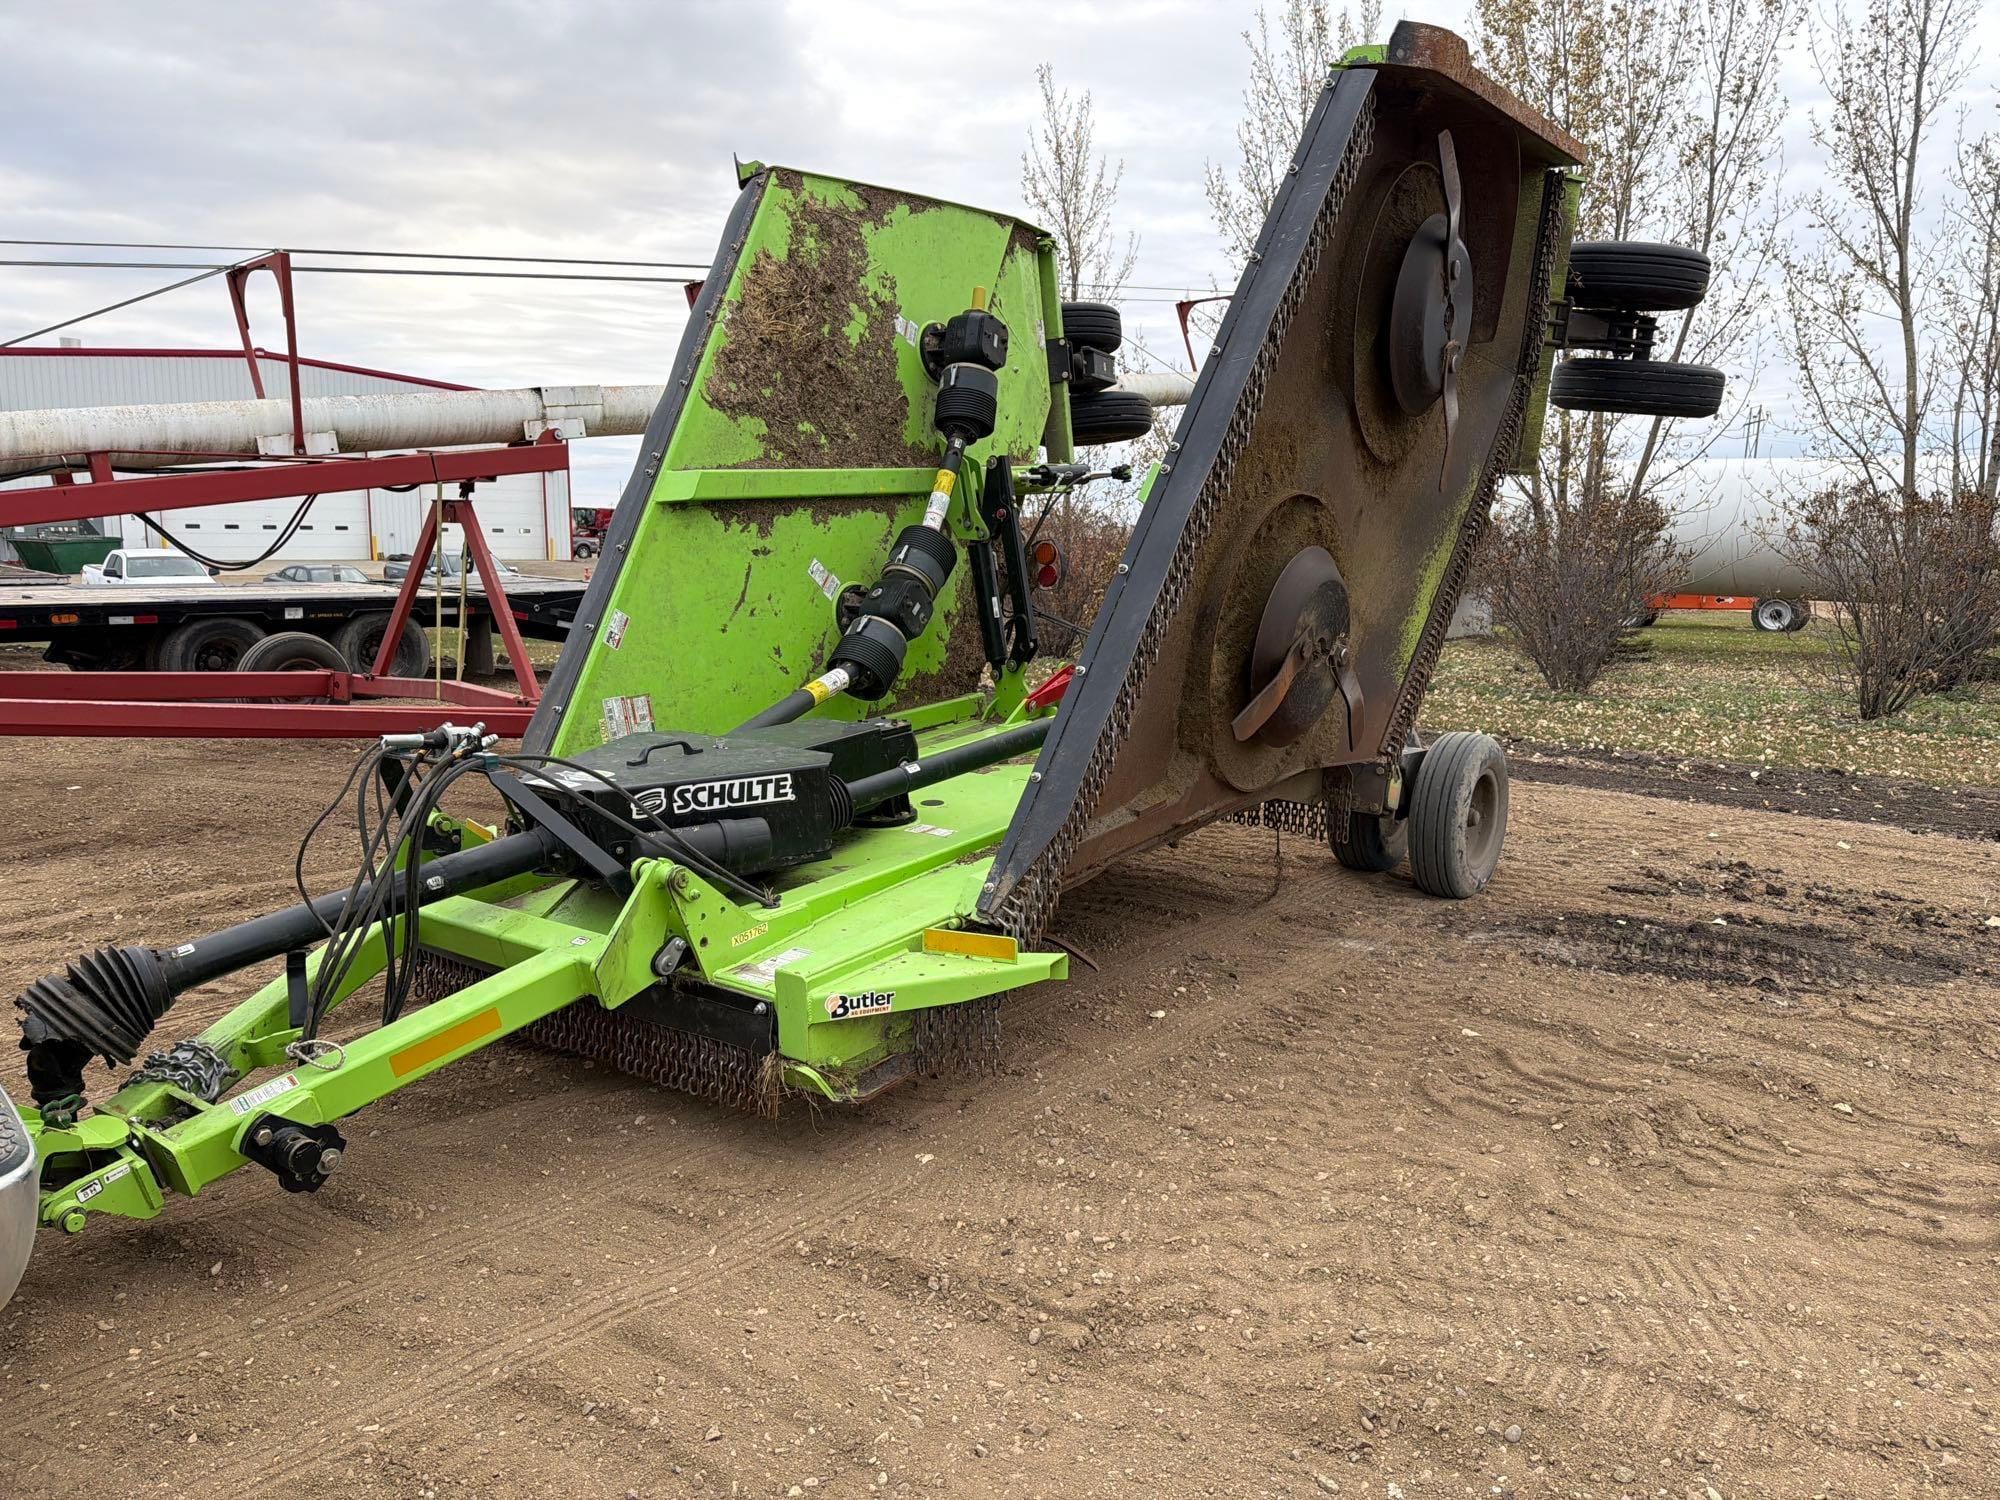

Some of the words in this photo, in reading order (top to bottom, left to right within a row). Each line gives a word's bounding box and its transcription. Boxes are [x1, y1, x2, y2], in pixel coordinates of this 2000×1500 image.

[674, 775, 791, 813] SCHULTE
[734, 923, 768, 945] X051762
[830, 992, 895, 1018] Butler
[860, 1006, 889, 1015] EQUIPMENT
